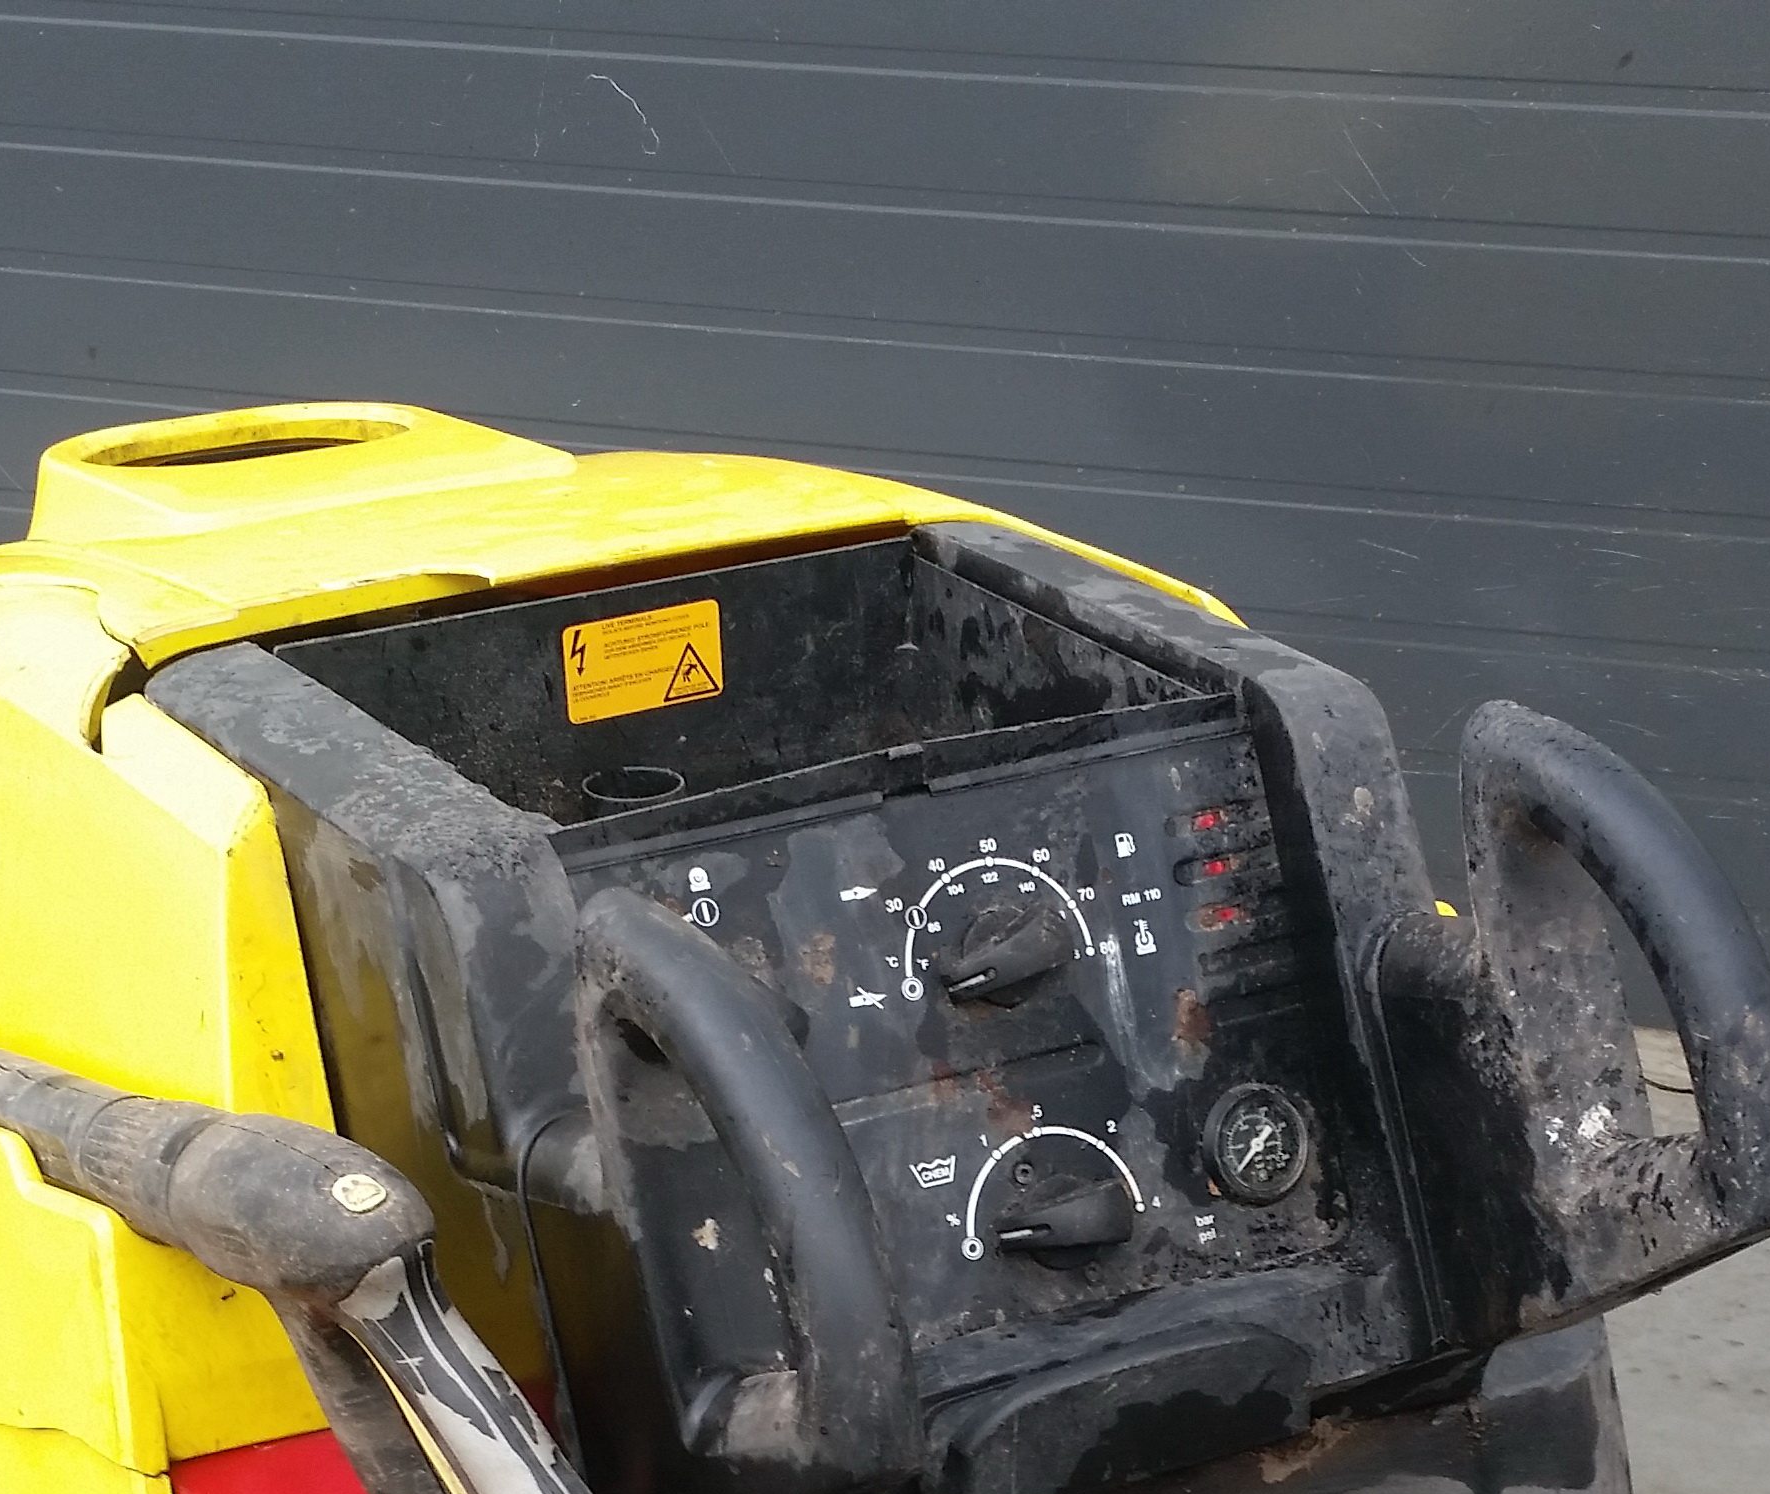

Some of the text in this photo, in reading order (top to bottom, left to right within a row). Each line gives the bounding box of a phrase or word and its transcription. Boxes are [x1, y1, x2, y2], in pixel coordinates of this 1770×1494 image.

[978, 837, 998, 854] 50
[1032, 847, 1051, 863] 60
[927, 857, 946, 873] 40
[980, 871, 1000, 884] 122
[946, 883, 966, 897] 104
[1017, 881, 1036, 894] 140
[1077, 886, 1096, 902] 70
[1121, 887, 1163, 907] RM 110
[884, 897, 904, 914] 30
[1099, 940, 1116, 955] 80
[1105, 1119, 1118, 1134] 2
[979, 1133, 989, 1148] 1
[1151, 1195, 1162, 1208] 4
[1194, 1213, 1215, 1228] bar
[1198, 1227, 1217, 1245] psi
